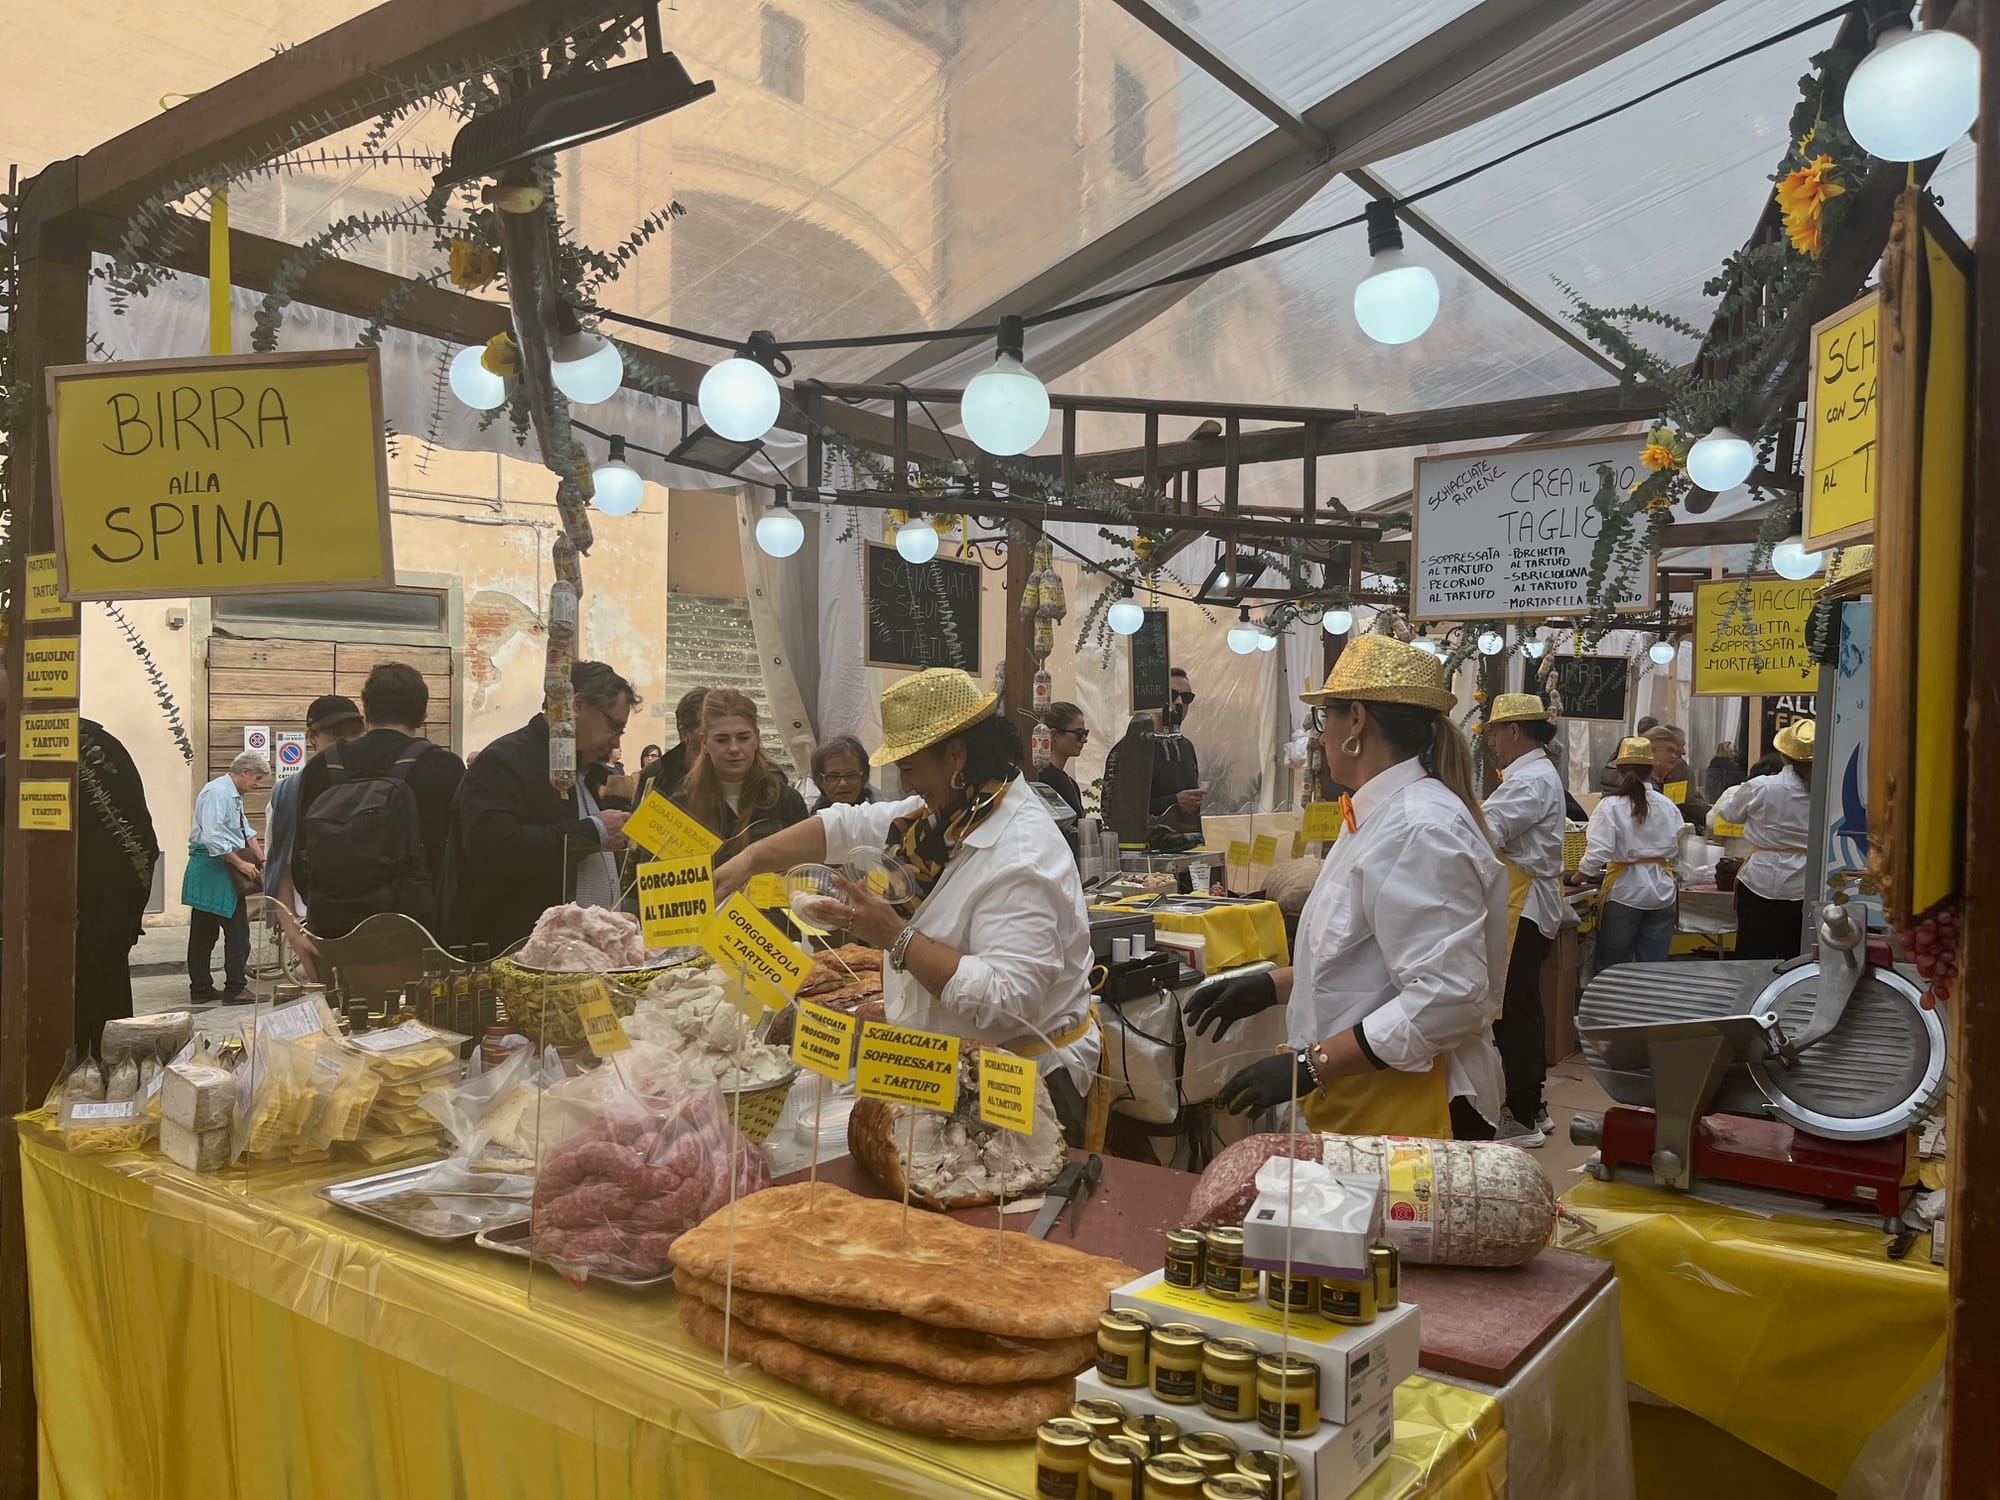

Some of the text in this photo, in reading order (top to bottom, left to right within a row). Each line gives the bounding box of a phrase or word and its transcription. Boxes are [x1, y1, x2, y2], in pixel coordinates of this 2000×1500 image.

[1824, 319, 1876, 384] SCH
[102, 386, 291, 456] BIRRA
[1826, 402, 1846, 423] CON
[1822, 439, 1877, 494] AL T
[168, 471, 221, 495] ALLA
[1427, 459, 1491, 512] SCHIACCIATE
[1452, 465, 1507, 507] RIPIENE
[1511, 467, 1573, 503] CREA
[1579, 480, 1592, 493] IL
[91, 500, 284, 566] SPINA
[1498, 504, 1600, 545] TAGLIE
[1428, 547, 1501, 566] SOPPRESSATA
[1510, 557, 1571, 569] AL TARTUFO
[1513, 547, 1566, 560] PORCHETTA
[877, 557, 976, 601] SCIACIATA
[1428, 563, 1494, 576] AL TARTUFO
[1511, 567, 1588, 582] SBRICIOLONA
[32, 583, 59, 599] TARTUF
[1429, 577, 1485, 590] PECORINO
[1513, 580, 1578, 592] AL TARTUFO
[1429, 589, 1496, 603] AL TARTUFO
[1509, 595, 1584, 609] MORTADELLA
[1711, 587, 1820, 617] SHIACCIA
[26, 651, 76, 663] TAGLIOLINI
[27, 670, 69, 682] ALL'UOVO
[1560, 663, 1603, 684] IRRA
[32, 737, 70, 748] TARTUFO
[645, 899, 707, 921] AL TARTUFO
[728, 910, 800, 977] GORGO&ZOLA
[733, 938, 783, 983] TARTUFO
[801, 1024, 840, 1046] PROSCIUTTO
[865, 1027, 949, 1052] SCHIACCIATA
[800, 1040, 808, 1050] AL
[809, 1044, 841, 1062] TARTUFO
[863, 1049, 953, 1075] SOPPRESSATA
[984, 1059, 1024, 1076] SCHIACCIATA
[883, 1074, 941, 1094] TARTUFO
[996, 1097, 1023, 1113] TARTUFO
